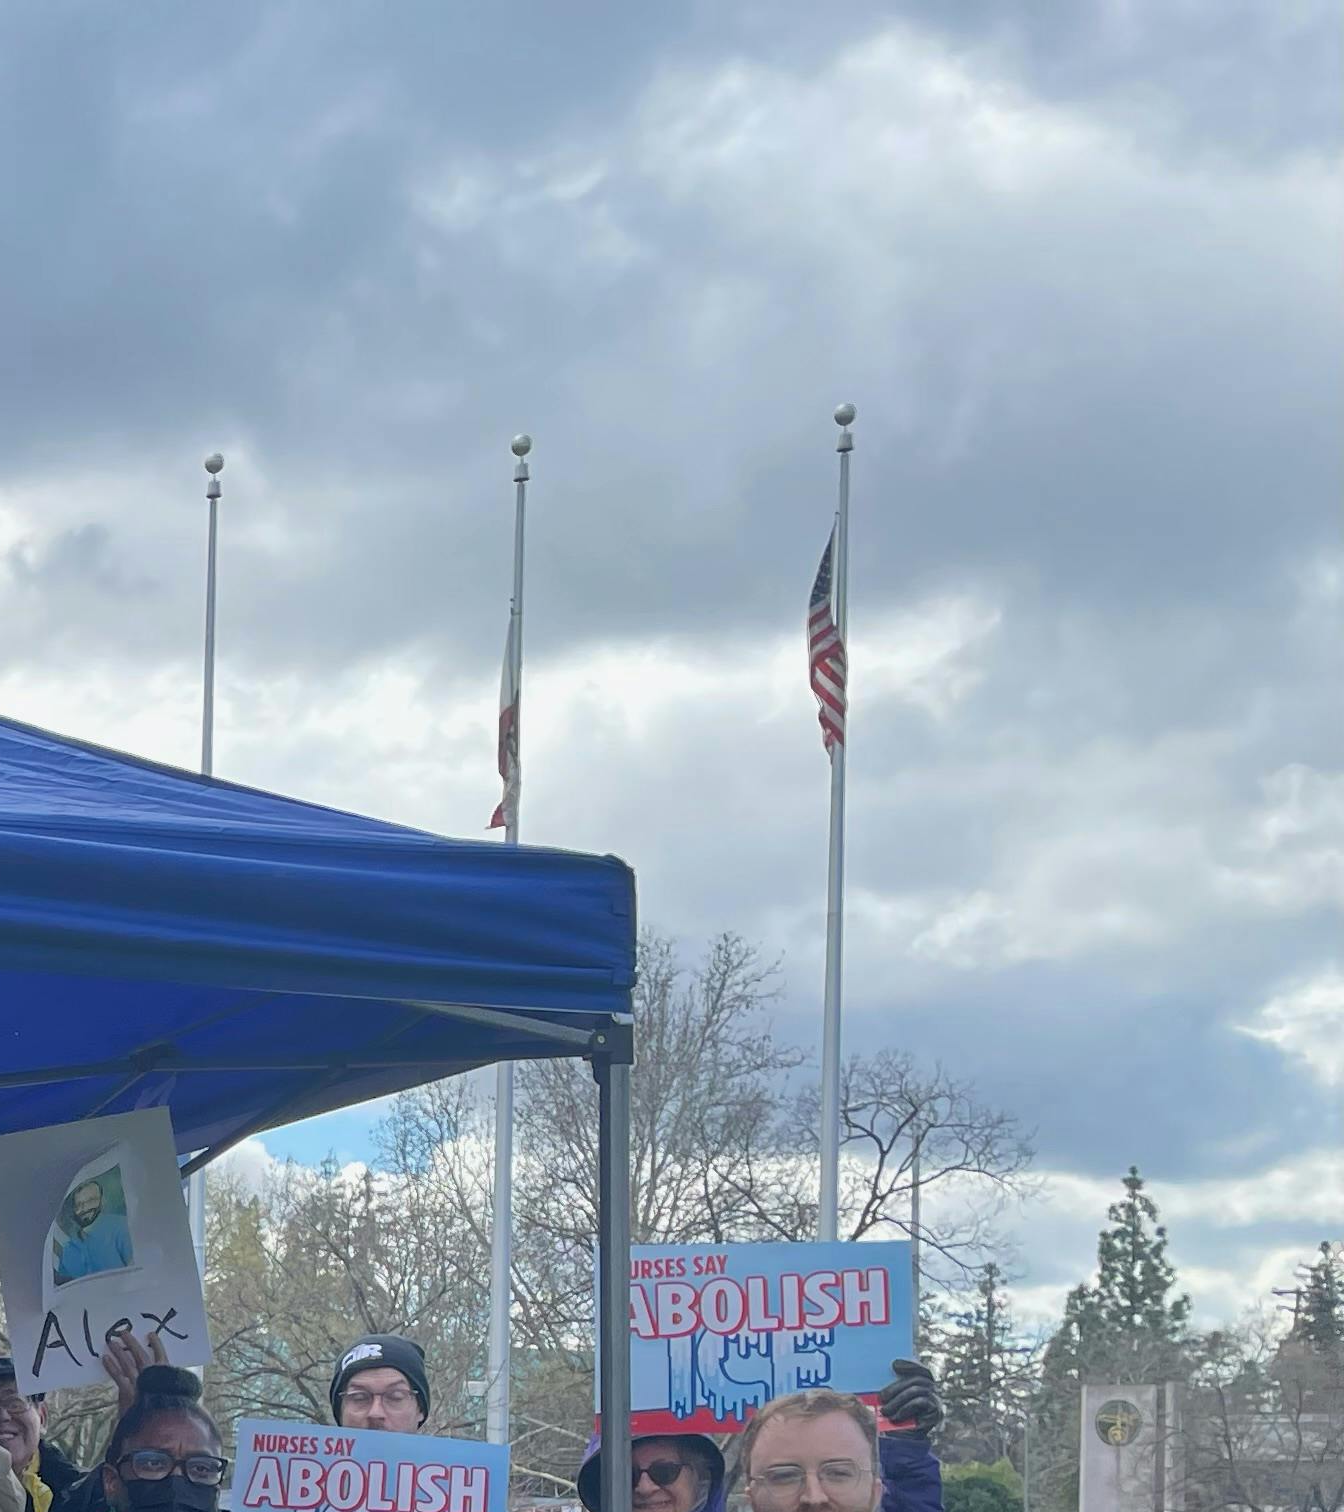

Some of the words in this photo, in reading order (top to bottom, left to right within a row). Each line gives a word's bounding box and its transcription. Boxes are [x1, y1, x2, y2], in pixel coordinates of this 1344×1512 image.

[630, 1256, 686, 1280] URSES
[693, 1254, 729, 1276] SAY
[32, 1307, 189, 1378] Alex
[667, 1328, 835, 1422] ICE
[253, 1433, 319, 1455] NURSES
[324, 1437, 356, 1457] SAY
